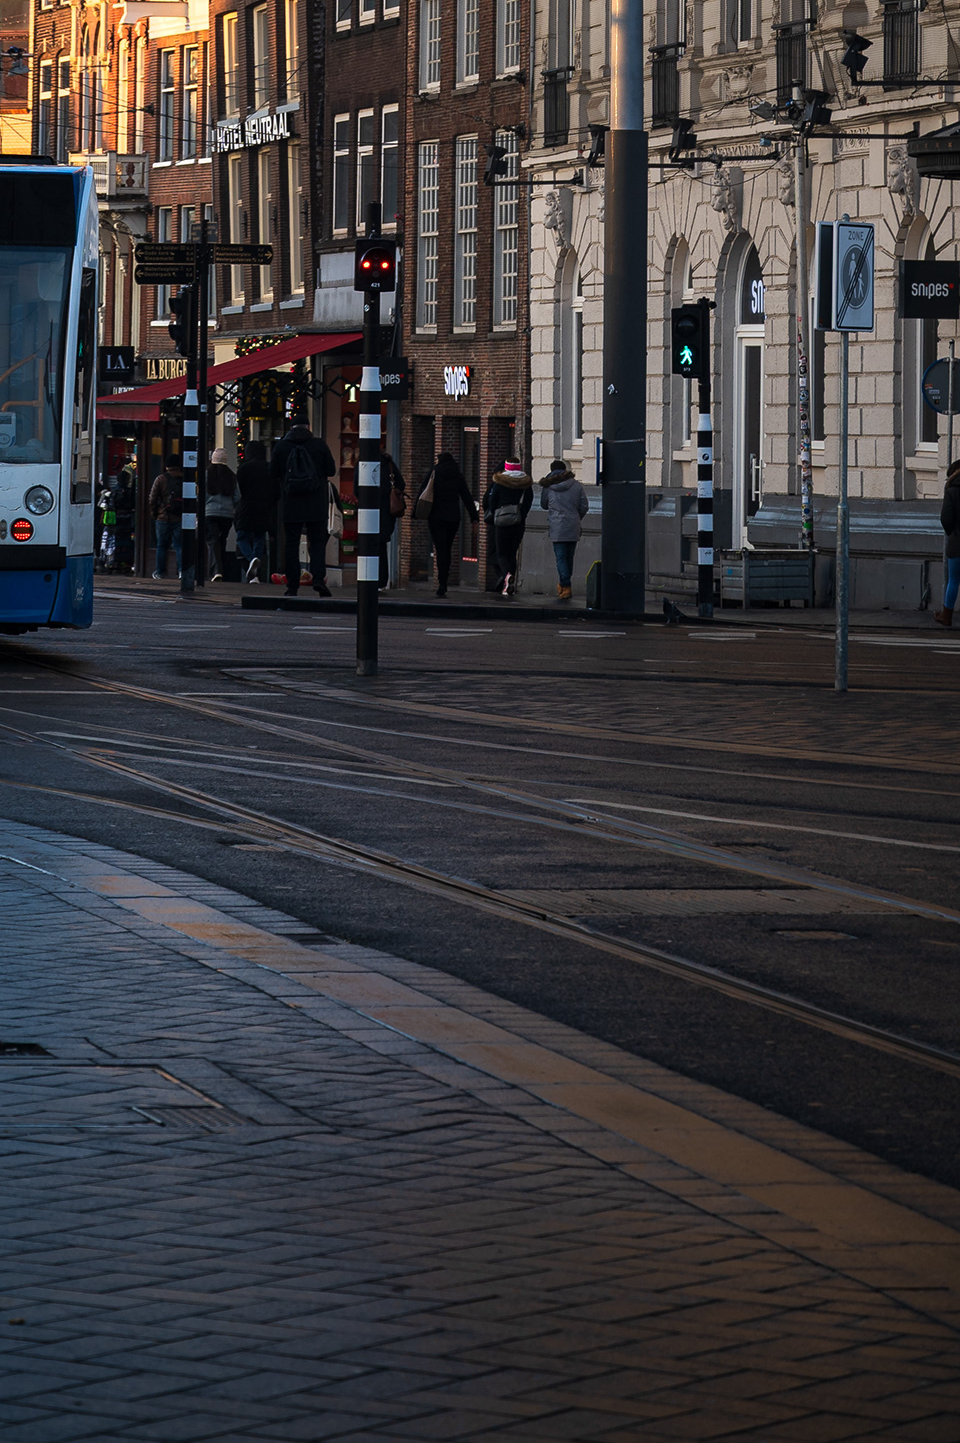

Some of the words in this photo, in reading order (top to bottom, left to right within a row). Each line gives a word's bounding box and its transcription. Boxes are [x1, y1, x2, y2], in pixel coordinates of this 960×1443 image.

[217, 123, 244, 153] HOTEL
[245, 112, 290, 147] NEUTRAAL
[848, 230, 864, 241] ZONE
[911, 282, 950, 299] snipes
[158, 359, 187, 380] BURGE
[379, 373, 401, 386] nipes
[444, 366, 469, 401] snipes
